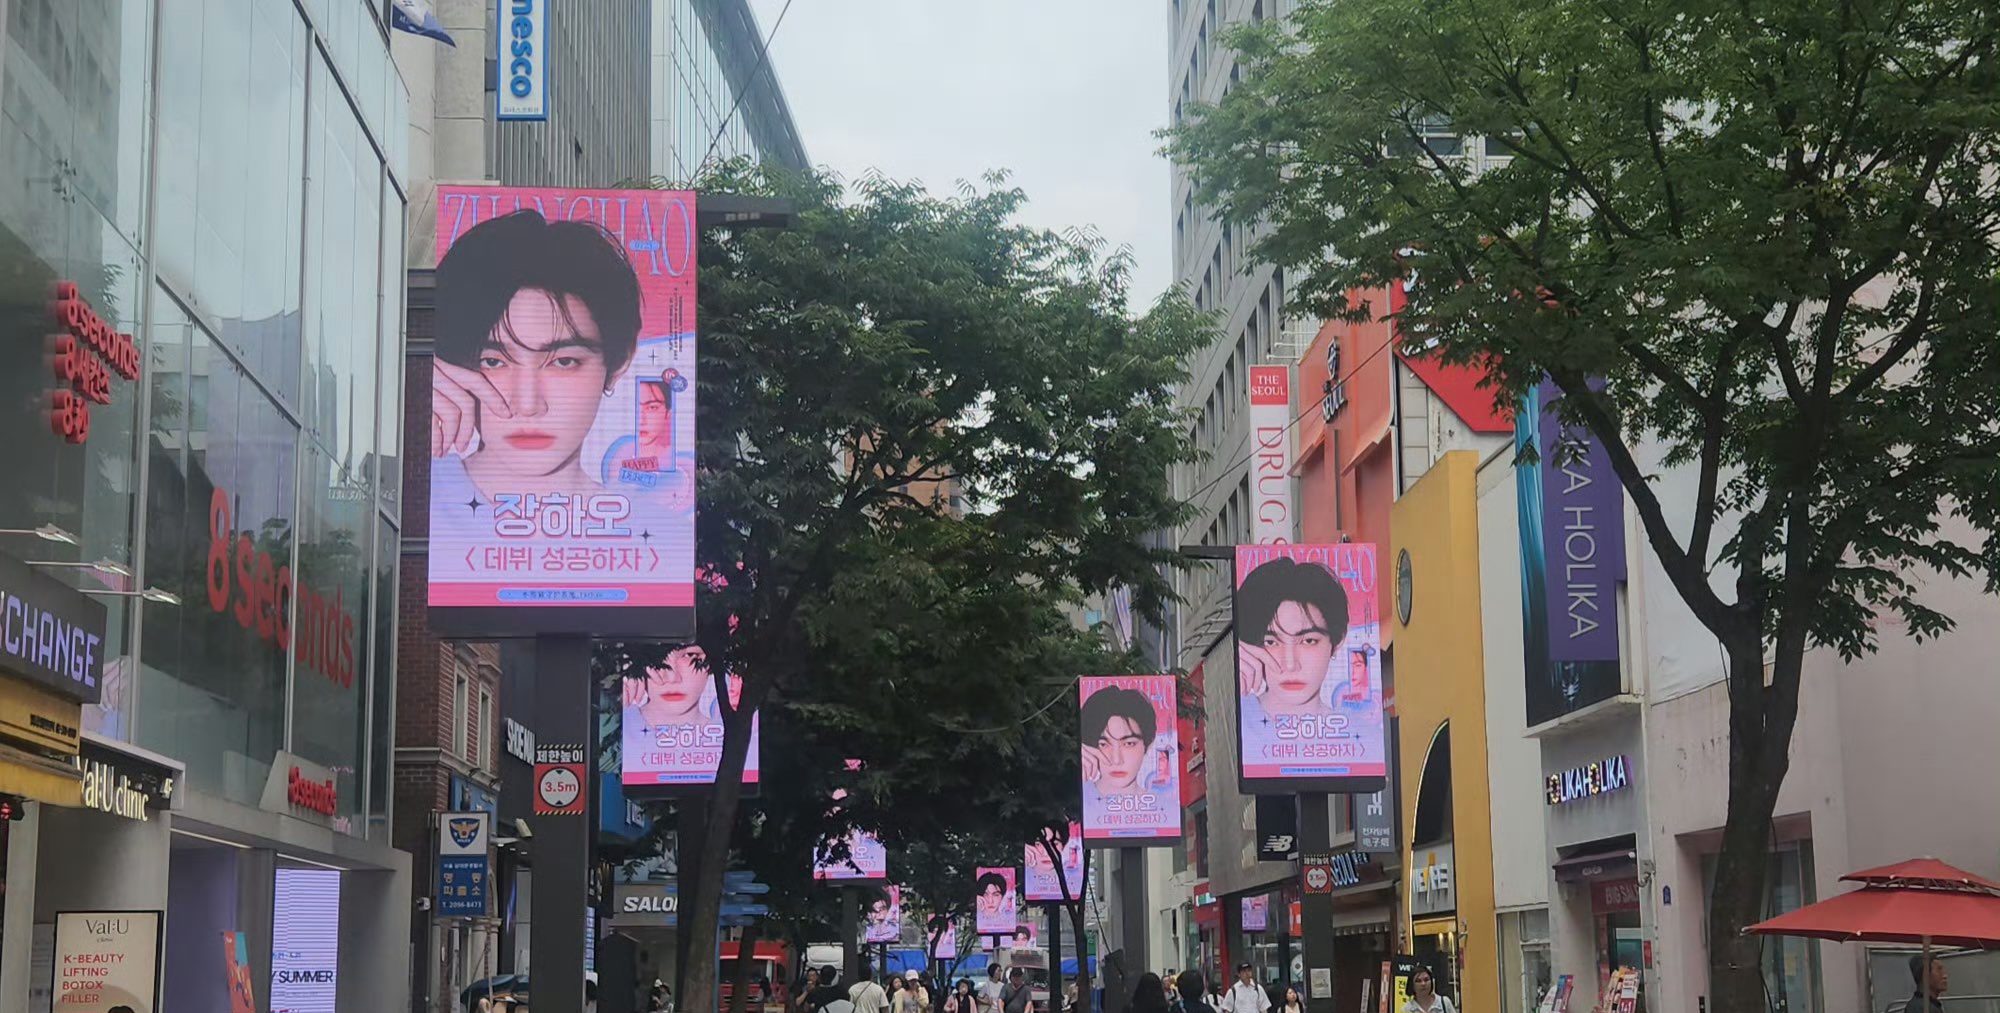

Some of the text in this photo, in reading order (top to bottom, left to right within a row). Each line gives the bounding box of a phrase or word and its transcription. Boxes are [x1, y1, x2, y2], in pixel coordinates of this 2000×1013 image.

[56, 281, 141, 382] 8seconds
[1256, 374, 1280, 385] THE
[1251, 386, 1287, 397] SEOUL
[1256, 424, 1288, 544] DRUG
[494, 492, 633, 540] 장하오
[483, 546, 643, 573] 데뷔 성공하자
[1562, 506, 1600, 639] HOLIKA
[207, 486, 354, 690] 8seconds
[0, 590, 100, 688] CHANGE
[1275, 713, 1350, 740] 장하오
[655, 723, 725, 748] 장하오
[536, 750, 583, 763] 제한높이
[651, 752, 723, 765] 데뷔 성공하
[1272, 744, 1356, 758] 데뷔 성공하자
[545, 781, 577, 793] 3.5m
[115, 774, 149, 822] clinic
[623, 896, 678, 912] SALO
[86, 918, 129, 936] Val:U
[63, 953, 124, 965] K-BEAUTY
[63, 967, 109, 978] LIFTING
[278, 970, 333, 983] SUMMER
[62, 981, 103, 991] BOTOX
[61, 994, 100, 1004] FILLER
